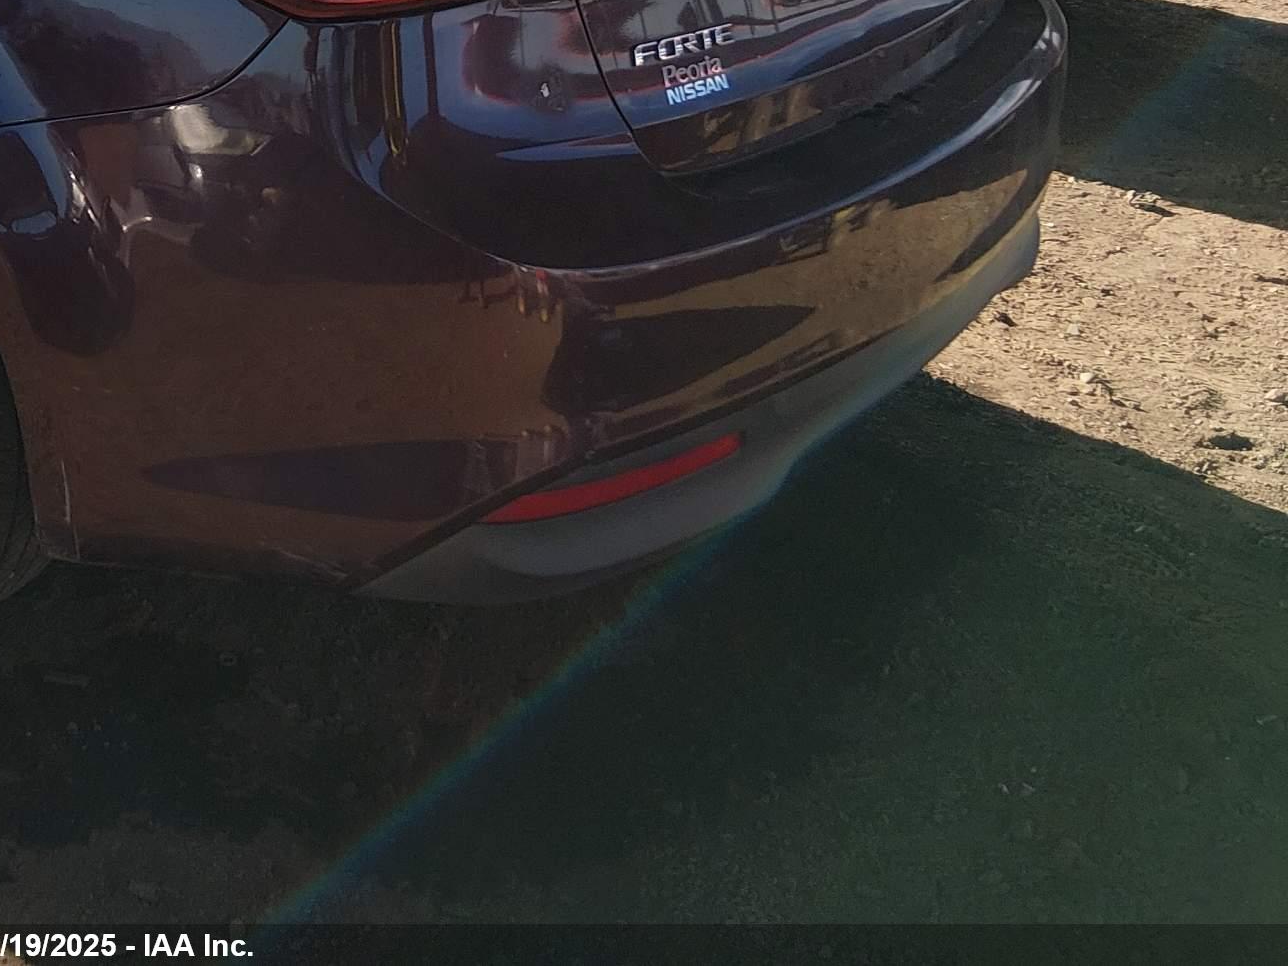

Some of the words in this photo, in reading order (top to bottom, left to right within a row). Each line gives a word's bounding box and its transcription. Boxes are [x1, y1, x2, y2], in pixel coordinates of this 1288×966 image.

[633, 22, 735, 67] FORTE
[662, 55, 723, 87] Peoria
[666, 73, 730, 105] NISSAN
